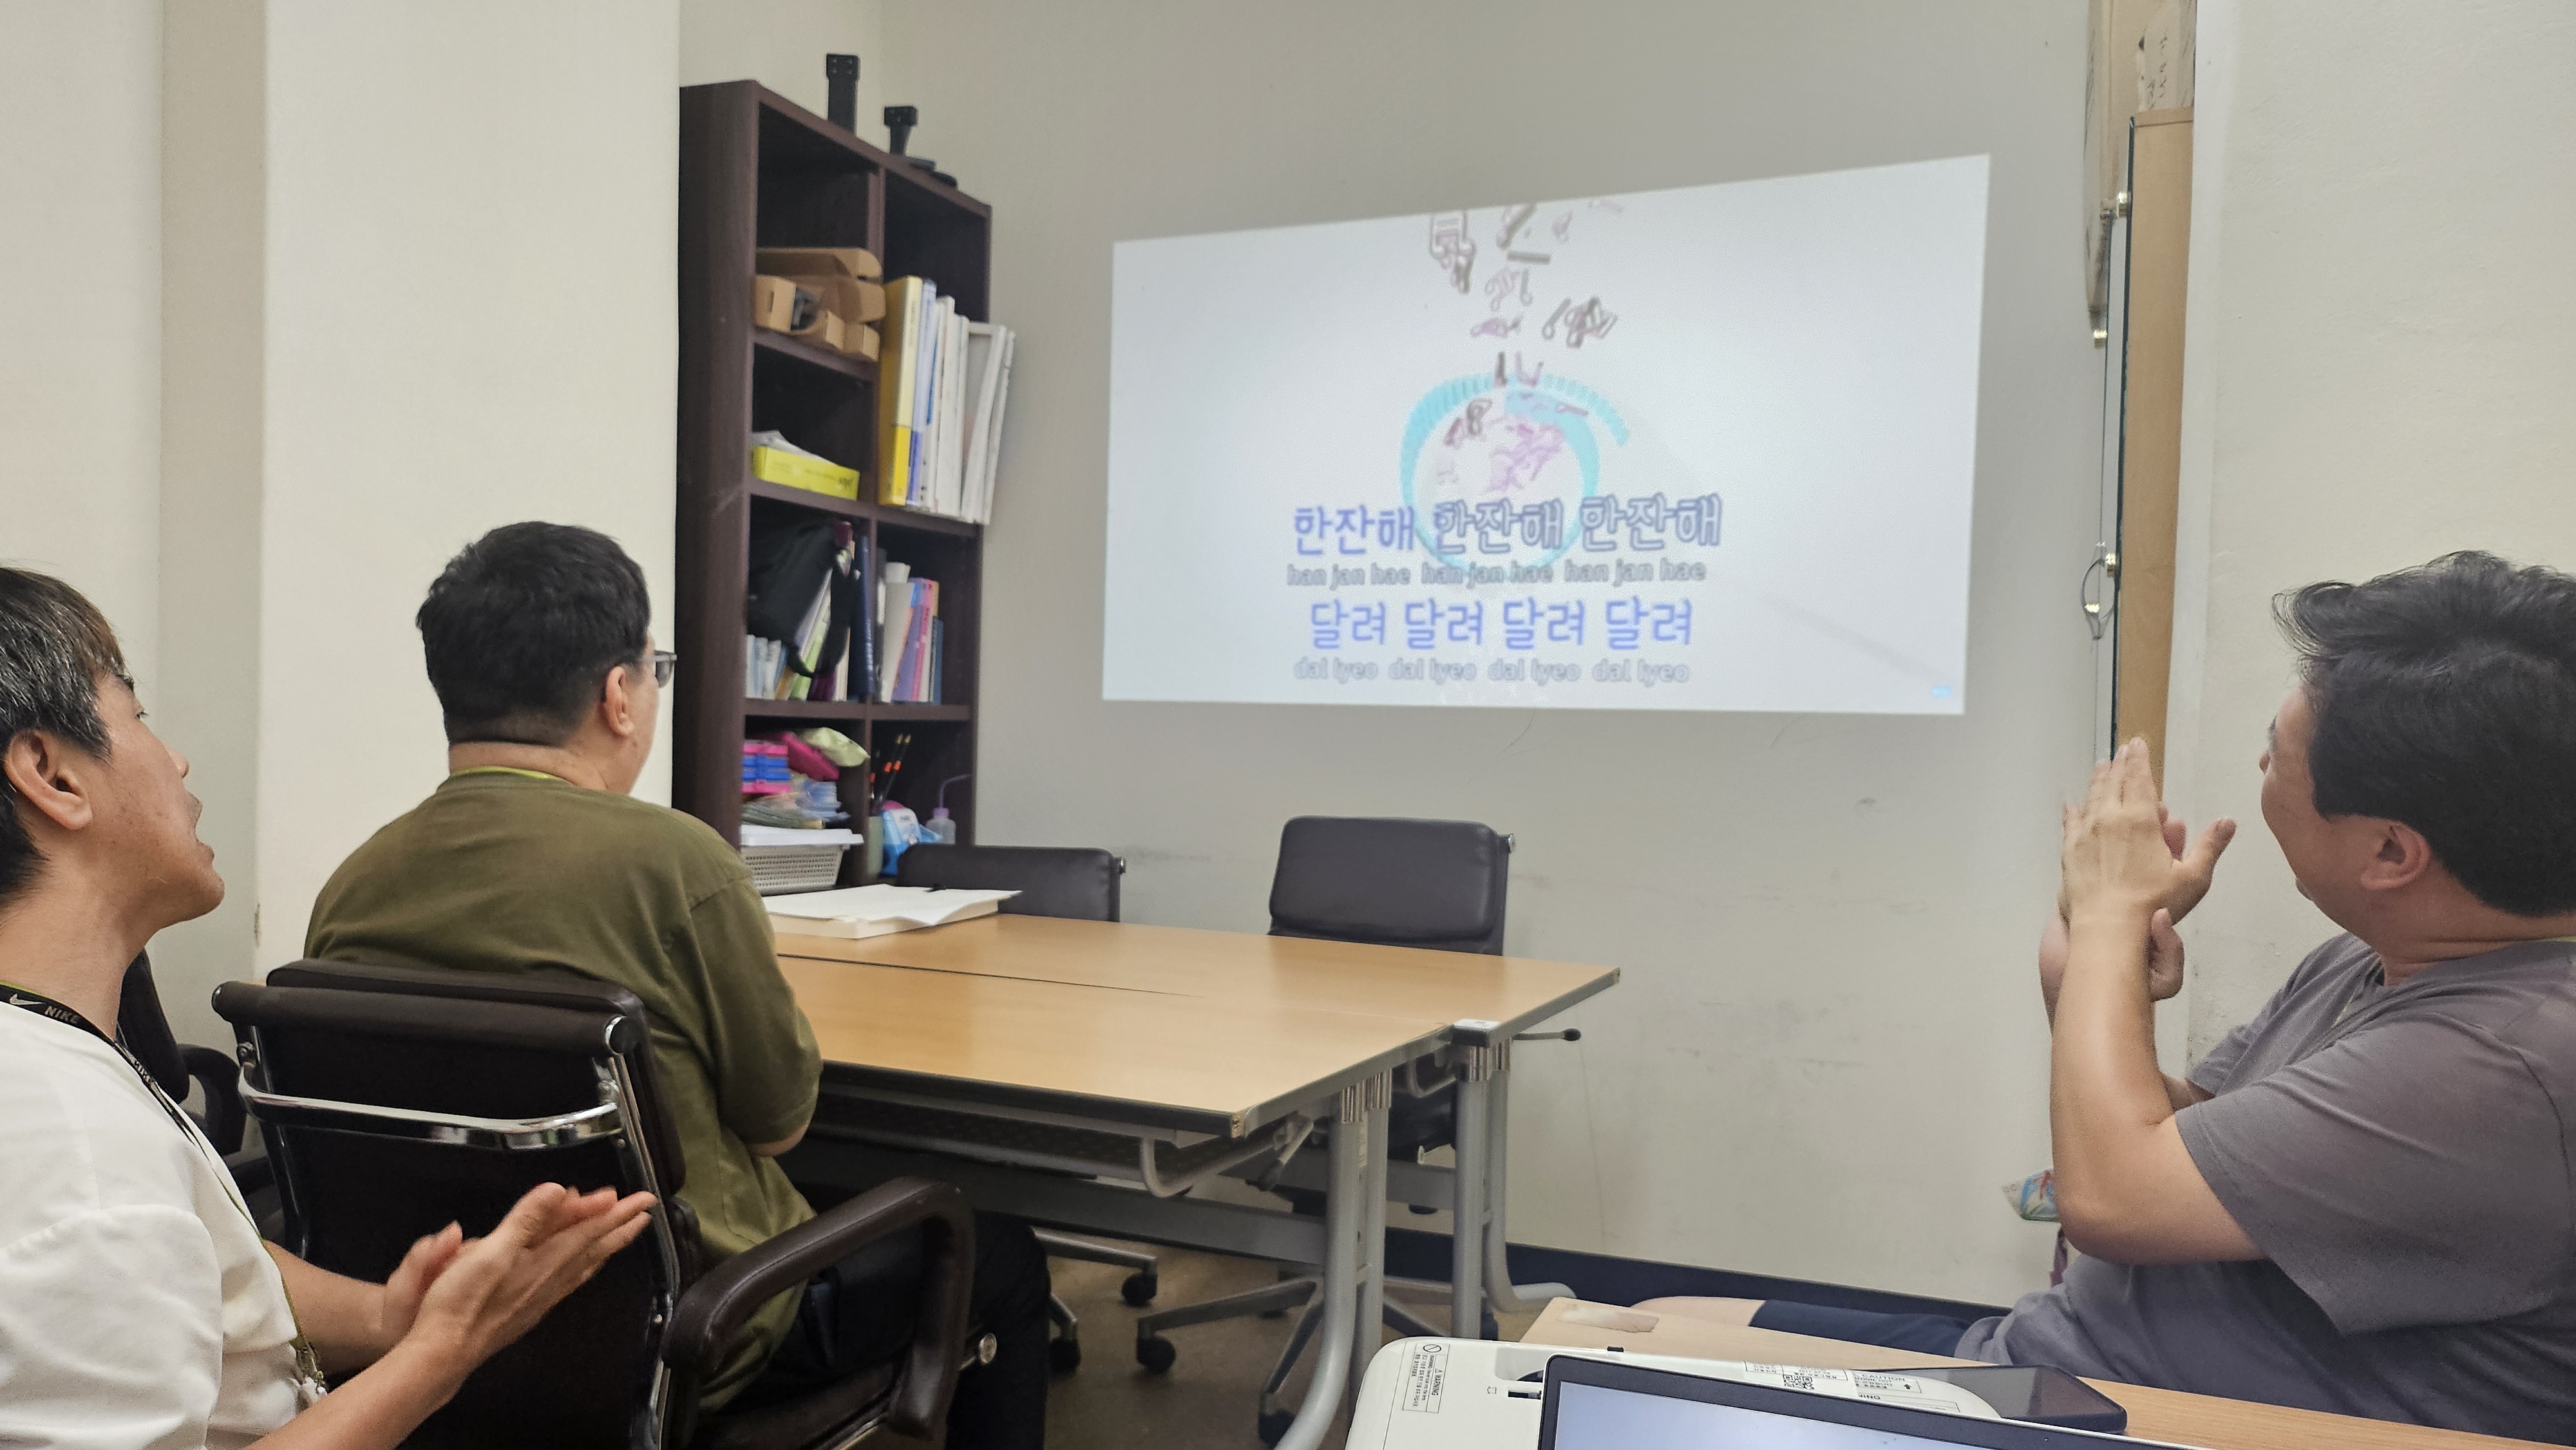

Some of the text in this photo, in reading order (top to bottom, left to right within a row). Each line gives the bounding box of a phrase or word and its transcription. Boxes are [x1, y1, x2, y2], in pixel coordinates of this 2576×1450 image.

[1294, 491, 1722, 556] 한잔해 한잔해 한잔해
[1287, 557, 1707, 590] han jan hae han jan hae han jan hae
[1311, 595, 1692, 650] 달려 달려 달려 달려
[1293, 656, 1690, 687] dal lyeo dal lyeo dal lyeo dal lyeo
[44, 1005, 81, 1024] NIKE
[1431, 1374, 1442, 1396] WARNING
